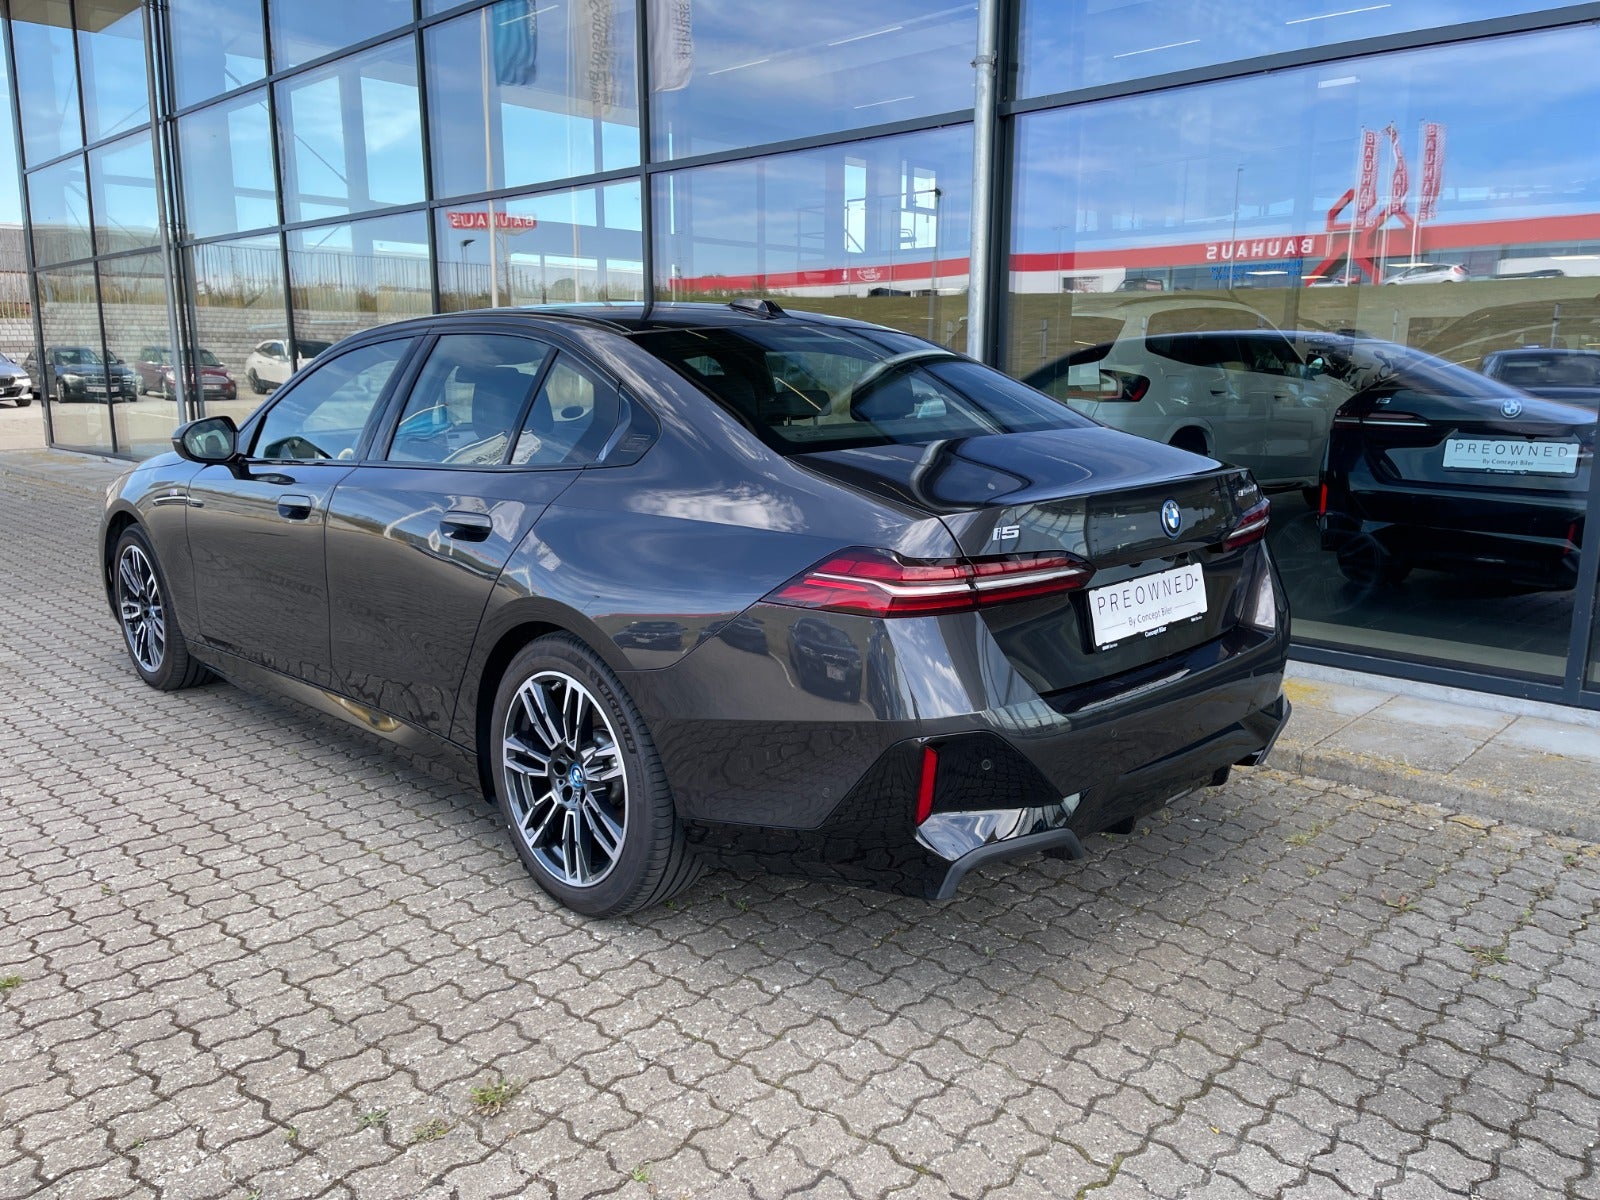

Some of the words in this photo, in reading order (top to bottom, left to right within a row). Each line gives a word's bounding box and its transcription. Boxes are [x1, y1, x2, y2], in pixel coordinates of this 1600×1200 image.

[1356, 132, 1375, 225] BAUHAUS
[1454, 442, 1569, 458] PREOWNED
[1491, 458, 1518, 467] Concept
[992, 525, 1020, 541] i5
[1097, 573, 1194, 615] PREOWNED
[1128, 615, 1136, 627] By
[1138, 609, 1160, 624] Concept
[1161, 606, 1173, 617] Biler
[598, 683, 636, 752] MICHELIN
